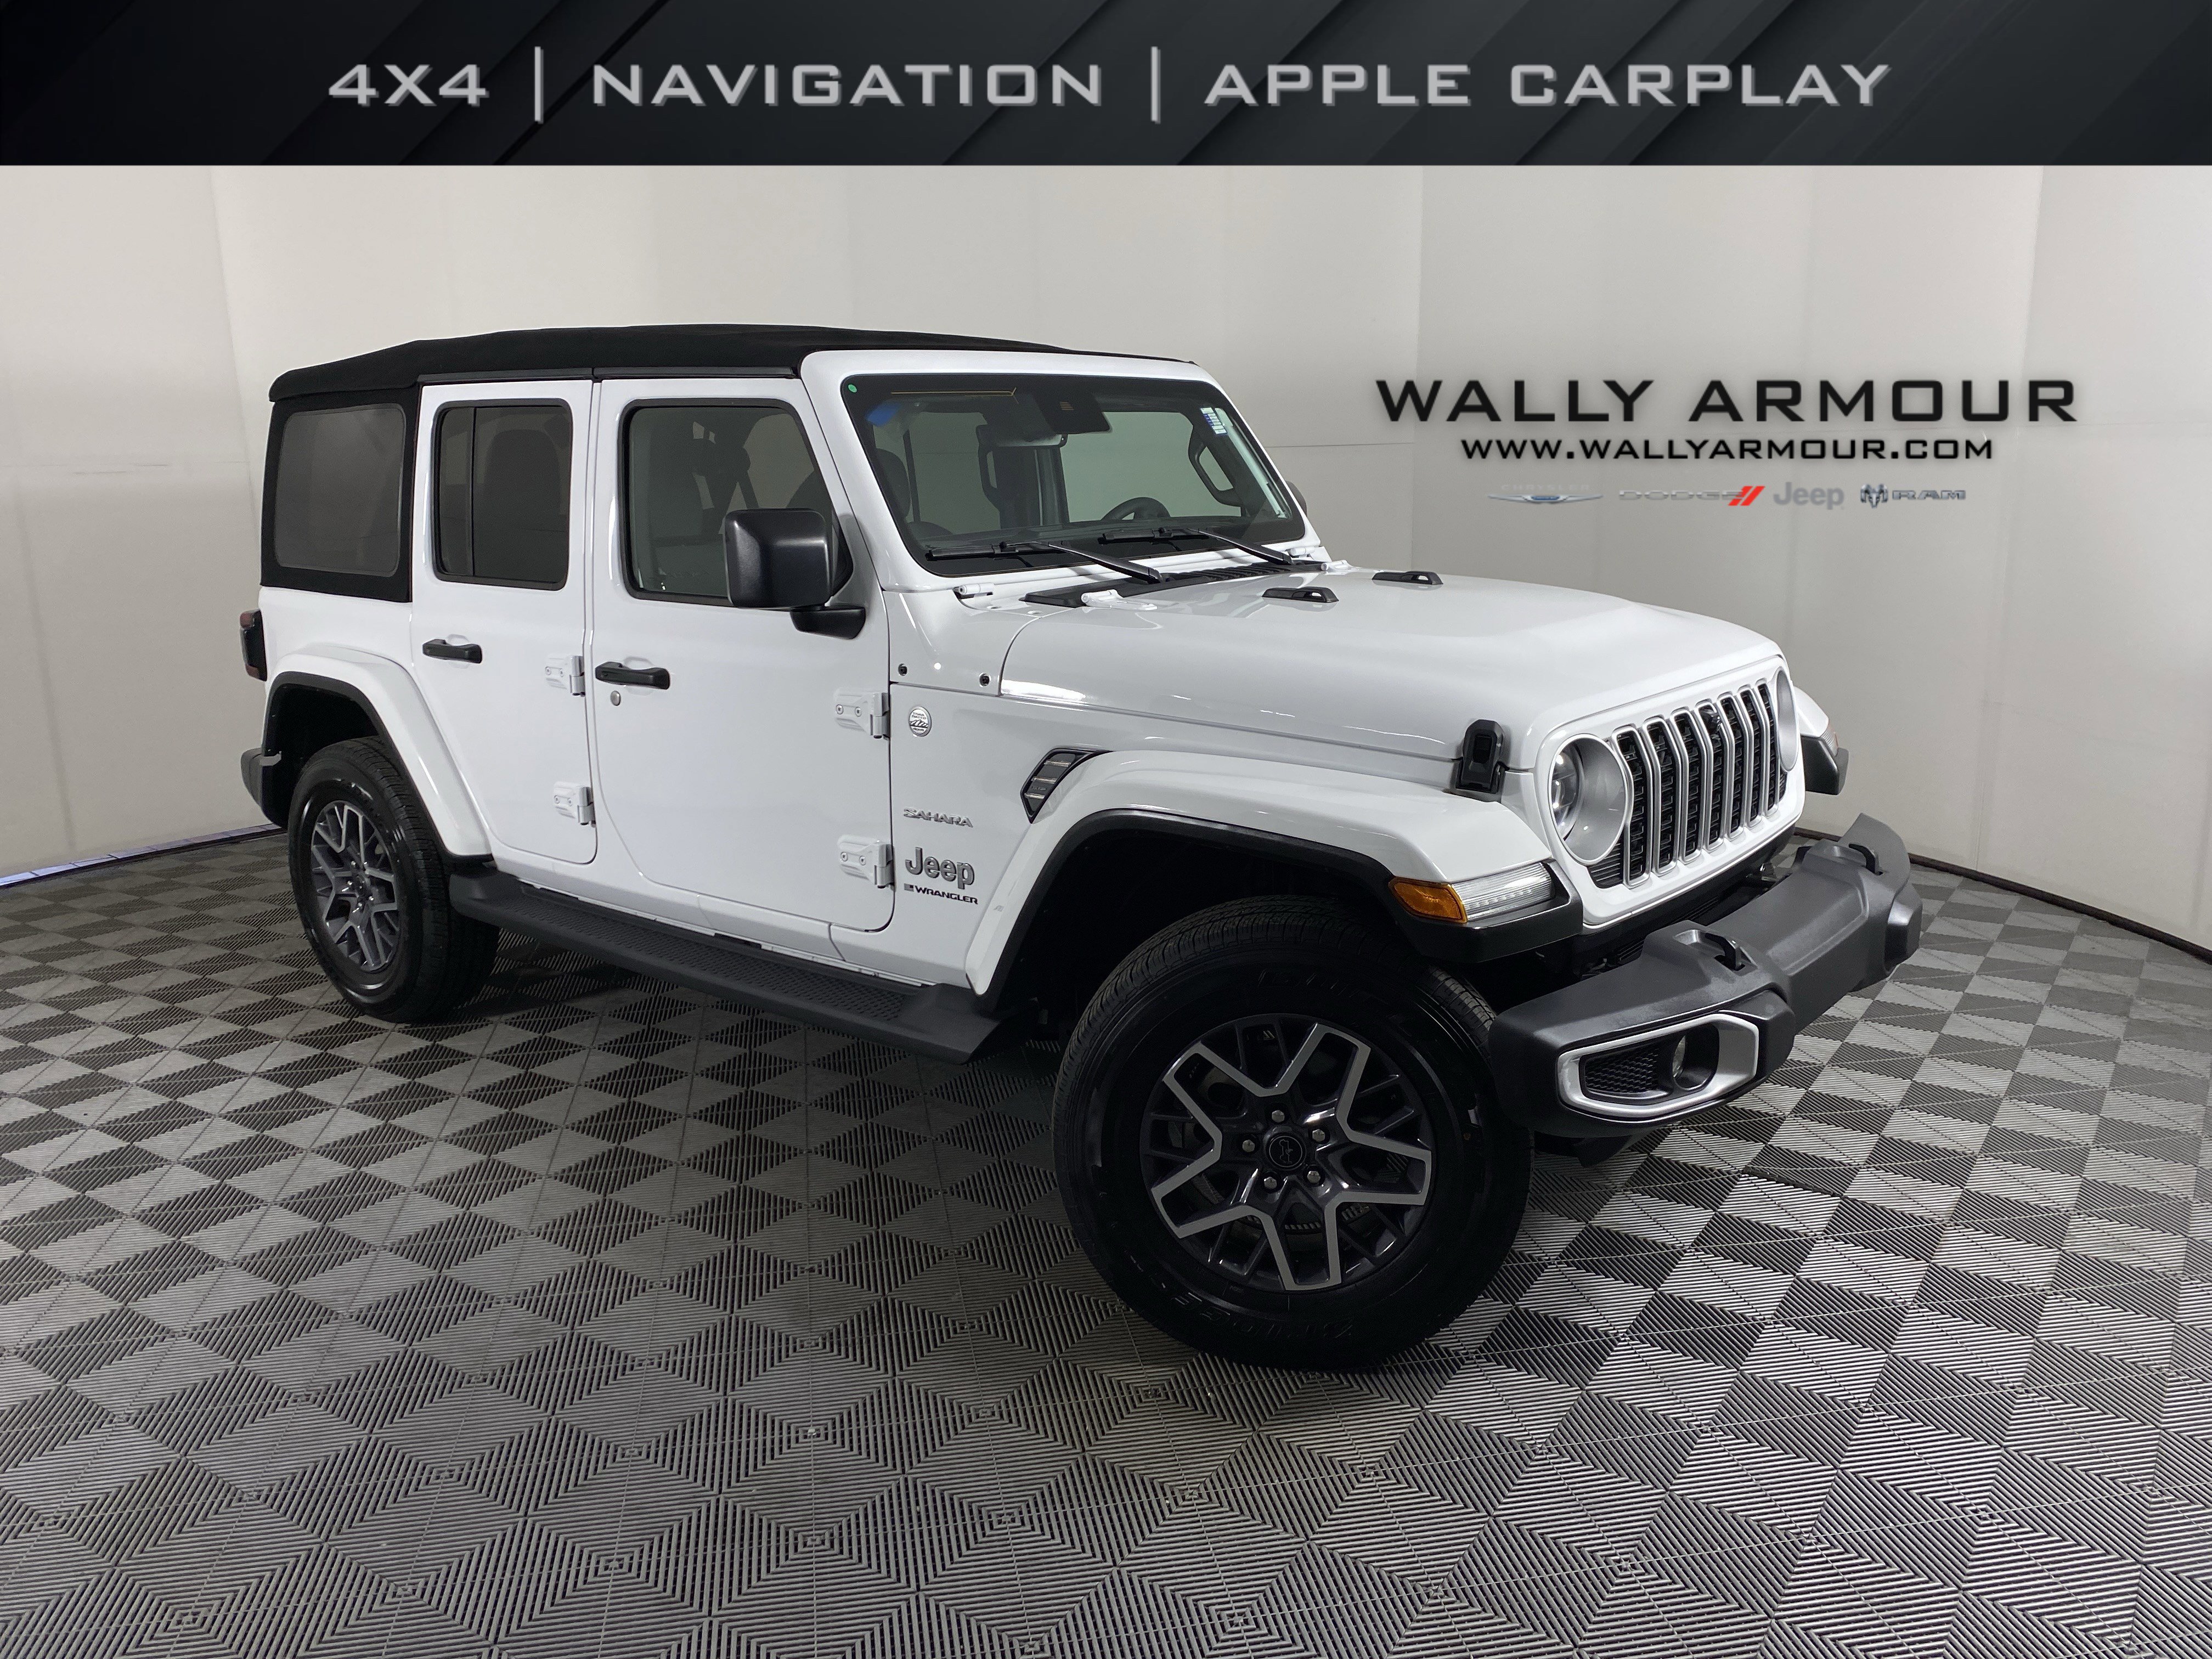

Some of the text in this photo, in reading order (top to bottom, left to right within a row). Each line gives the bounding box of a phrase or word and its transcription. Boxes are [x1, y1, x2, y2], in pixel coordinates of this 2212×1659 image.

[904, 808, 973, 828] SAHARA
[905, 847, 974, 889] Jeep
[915, 885, 978, 904] WRANGLER
